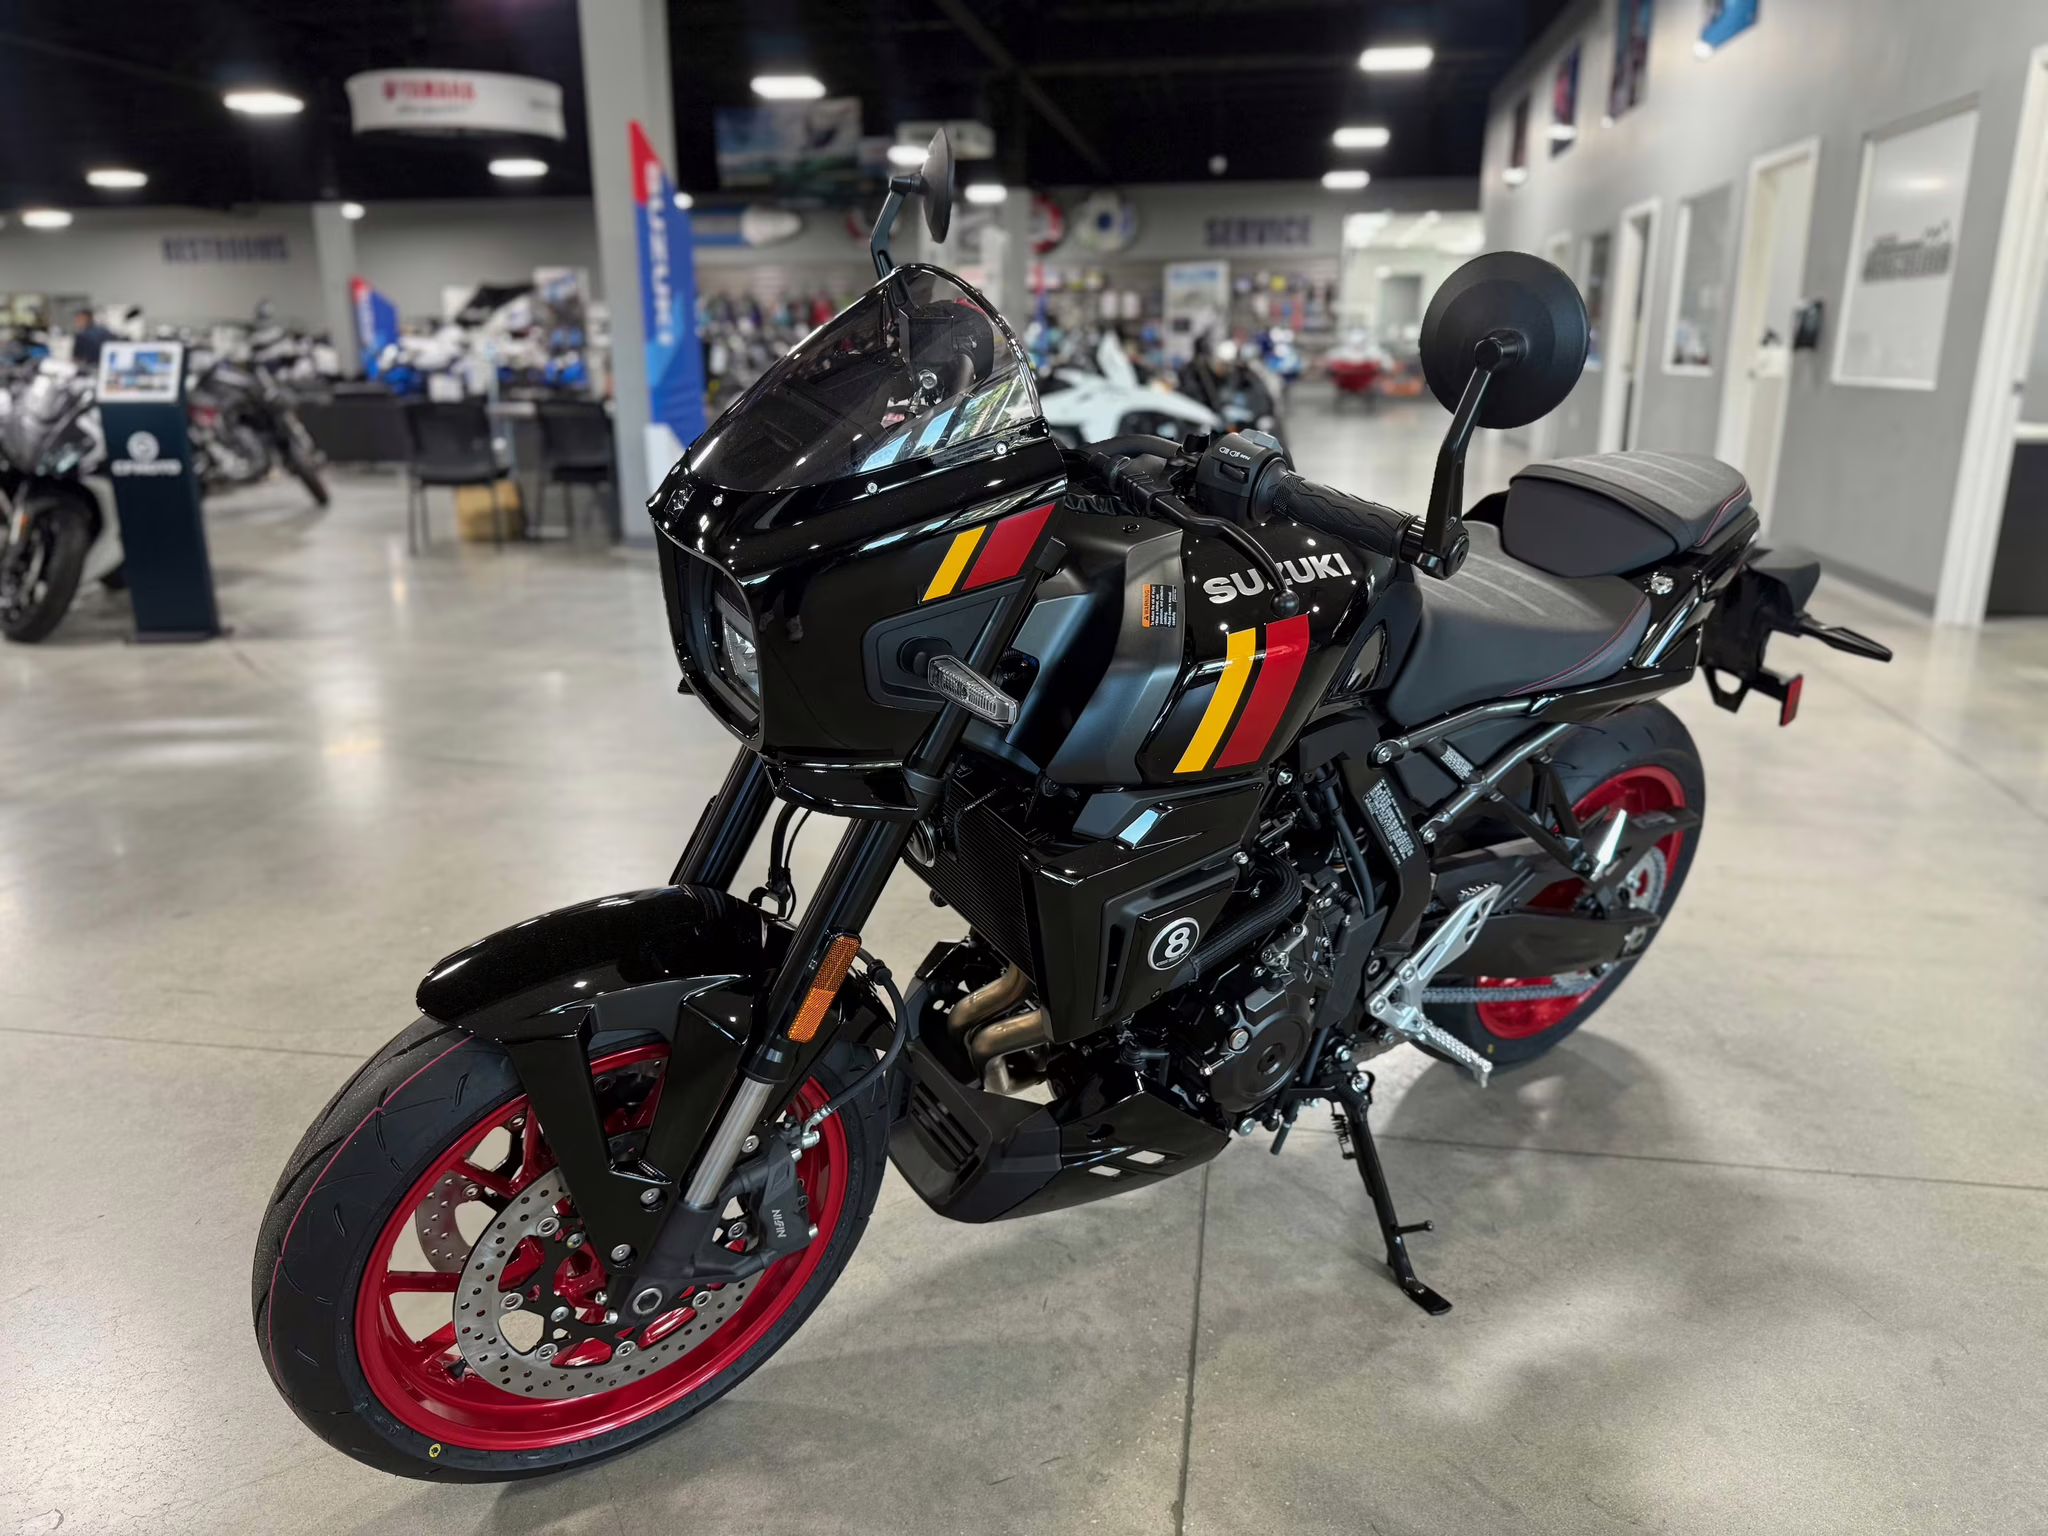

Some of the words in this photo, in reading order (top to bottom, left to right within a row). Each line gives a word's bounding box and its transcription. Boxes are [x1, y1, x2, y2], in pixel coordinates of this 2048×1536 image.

[1205, 217, 1311, 247] SERVICE
[643, 160, 675, 346] SUZUKI
[1165, 927, 1190, 958] 8
[771, 1209, 787, 1238] NISSIN
